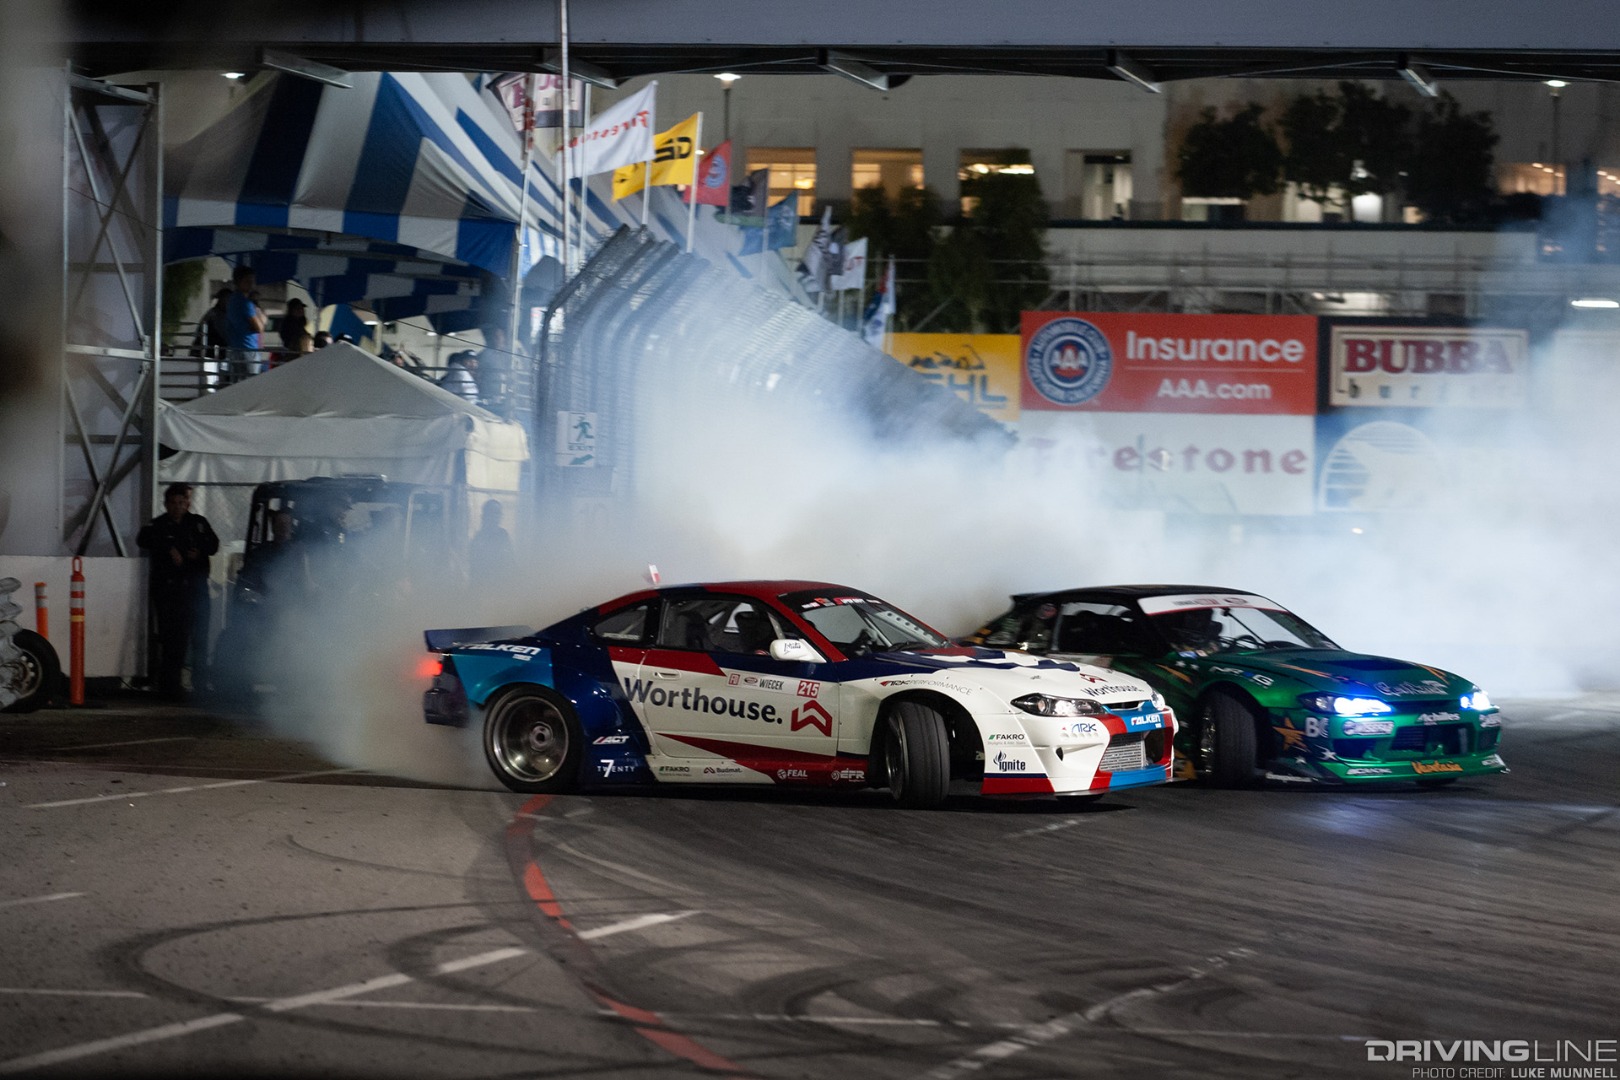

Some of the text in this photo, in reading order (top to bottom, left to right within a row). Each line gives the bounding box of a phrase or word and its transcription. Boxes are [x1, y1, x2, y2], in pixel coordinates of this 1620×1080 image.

[1125, 330, 1306, 363] Insurance
[1343, 339, 1514, 374] BUBBA
[1156, 378, 1272, 400] AAA.com
[1026, 434, 1308, 475] Frestone
[758, 678, 785, 691] WIECEK
[798, 682, 819, 697] 215
[909, 680, 973, 696] PERFORMANCE
[624, 677, 784, 725] Worthouse.
[1131, 714, 1161, 725] FALKEN
[999, 758, 1026, 772] ignite
[787, 769, 808, 778] FEAL
